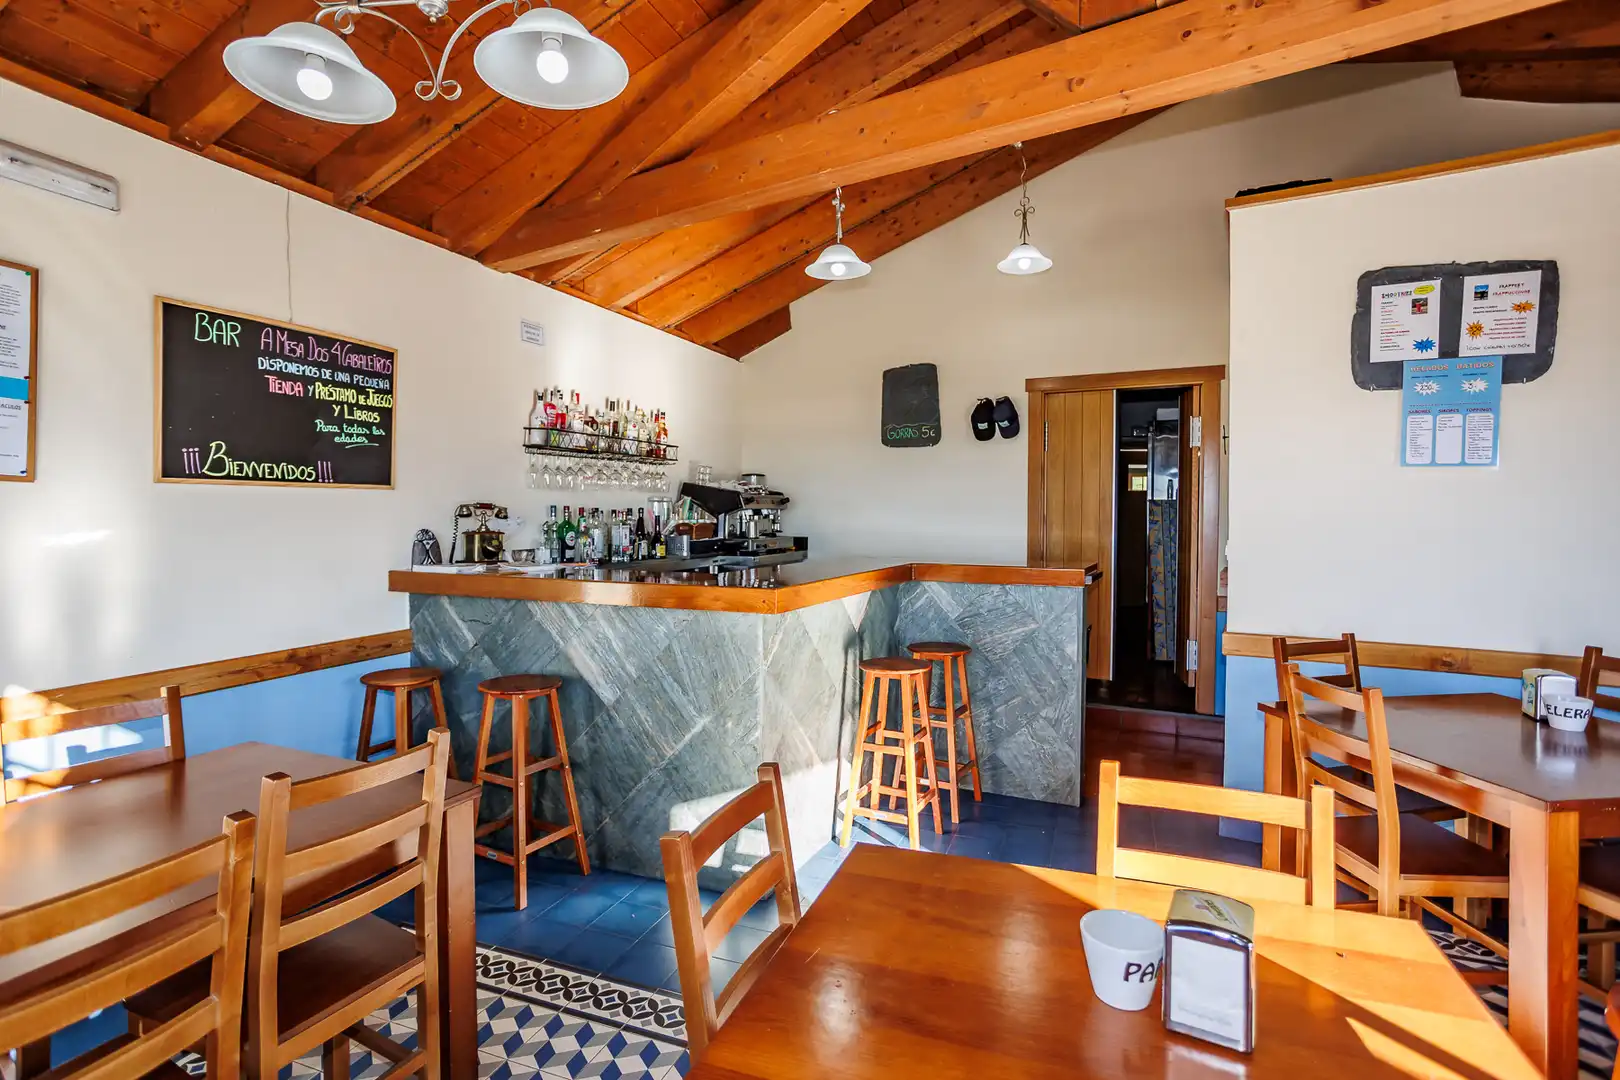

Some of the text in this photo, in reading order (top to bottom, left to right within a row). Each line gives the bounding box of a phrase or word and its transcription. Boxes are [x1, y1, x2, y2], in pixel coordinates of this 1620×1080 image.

[194, 312, 241, 348] BAR
[260, 327, 273, 352] A
[277, 329, 304, 359] MESA
[307, 336, 329, 363] DOS
[330, 341, 341, 365] 4
[321, 368, 333, 380] DE
[334, 371, 351, 384] UNA
[353, 374, 391, 390] PEQUEÑA
[358, 394, 366, 406] DE
[365, 388, 393, 408] JUEGOS
[314, 419, 386, 436] Para todas las
[887, 427, 919, 440] GORRAS
[334, 432, 369, 444] edades
[1544, 703, 1591, 720] ELERA
